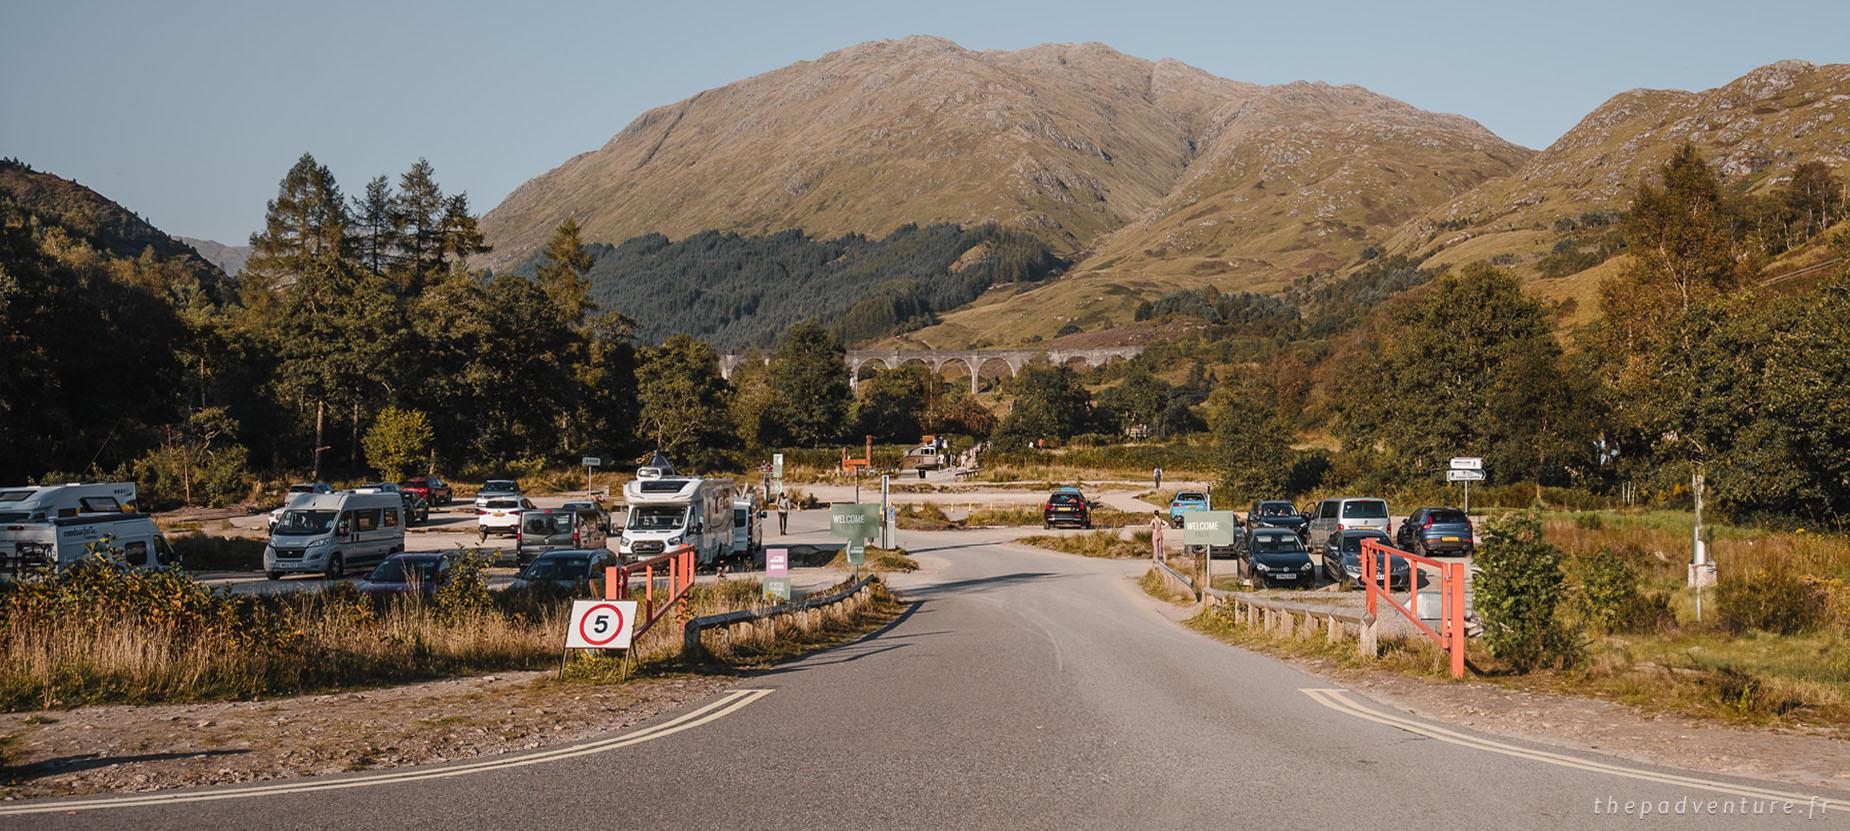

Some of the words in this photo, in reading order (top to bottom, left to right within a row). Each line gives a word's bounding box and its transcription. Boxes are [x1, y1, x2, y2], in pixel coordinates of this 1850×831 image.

[832, 514, 865, 524] WELCOME
[1186, 521, 1219, 531] WELCOME
[594, 615, 609, 633] 5
